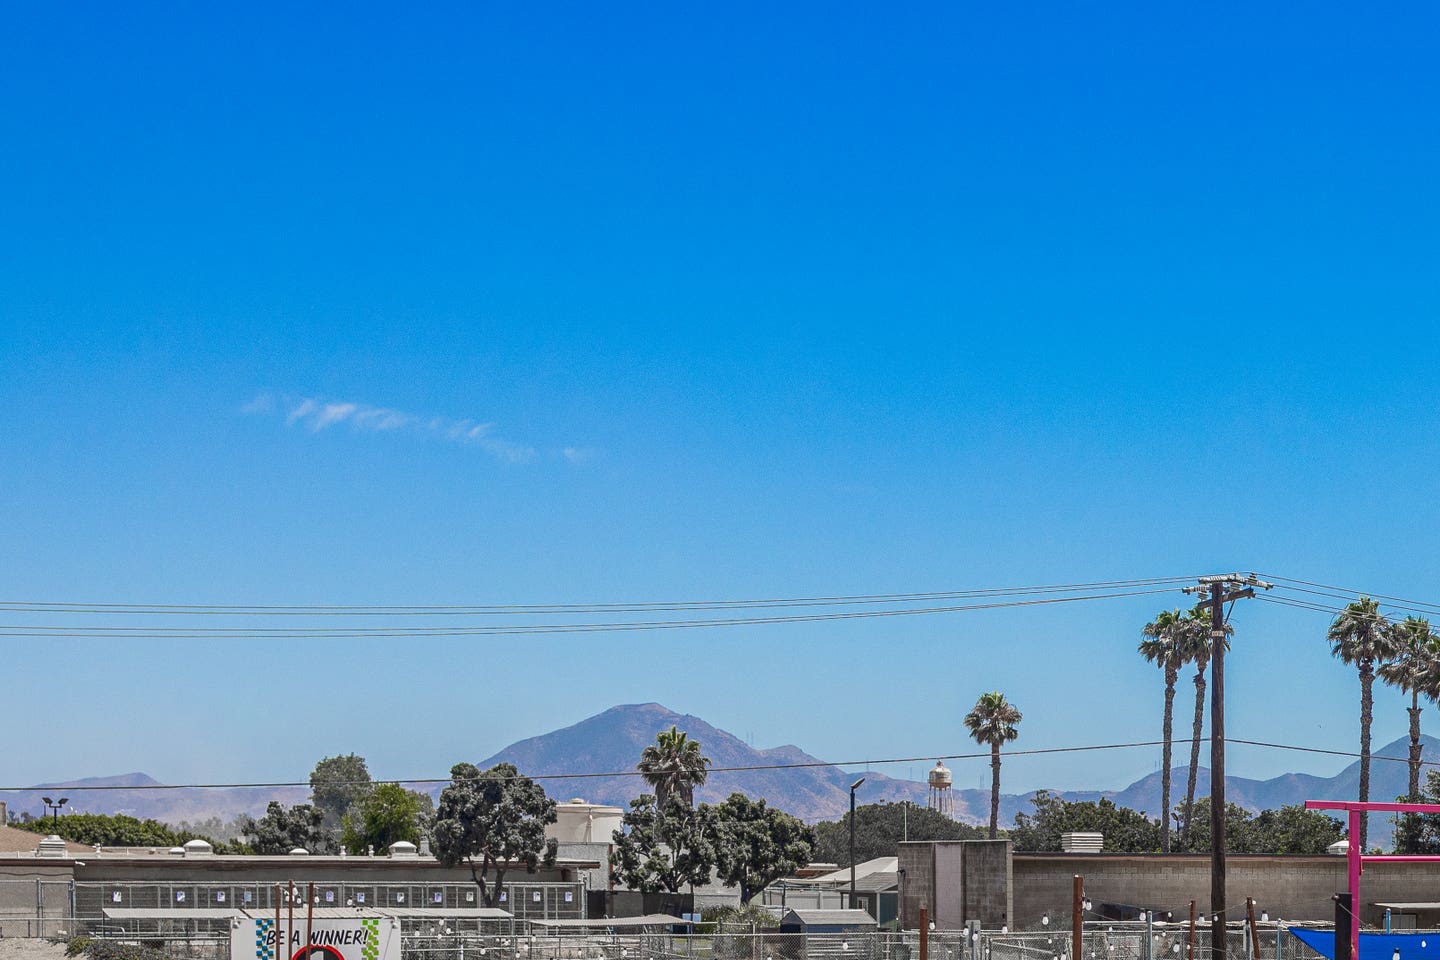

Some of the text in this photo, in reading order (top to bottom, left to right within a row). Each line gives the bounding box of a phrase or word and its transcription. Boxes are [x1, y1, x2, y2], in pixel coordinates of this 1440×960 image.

[266, 929, 369, 945] BE A WINNER!
